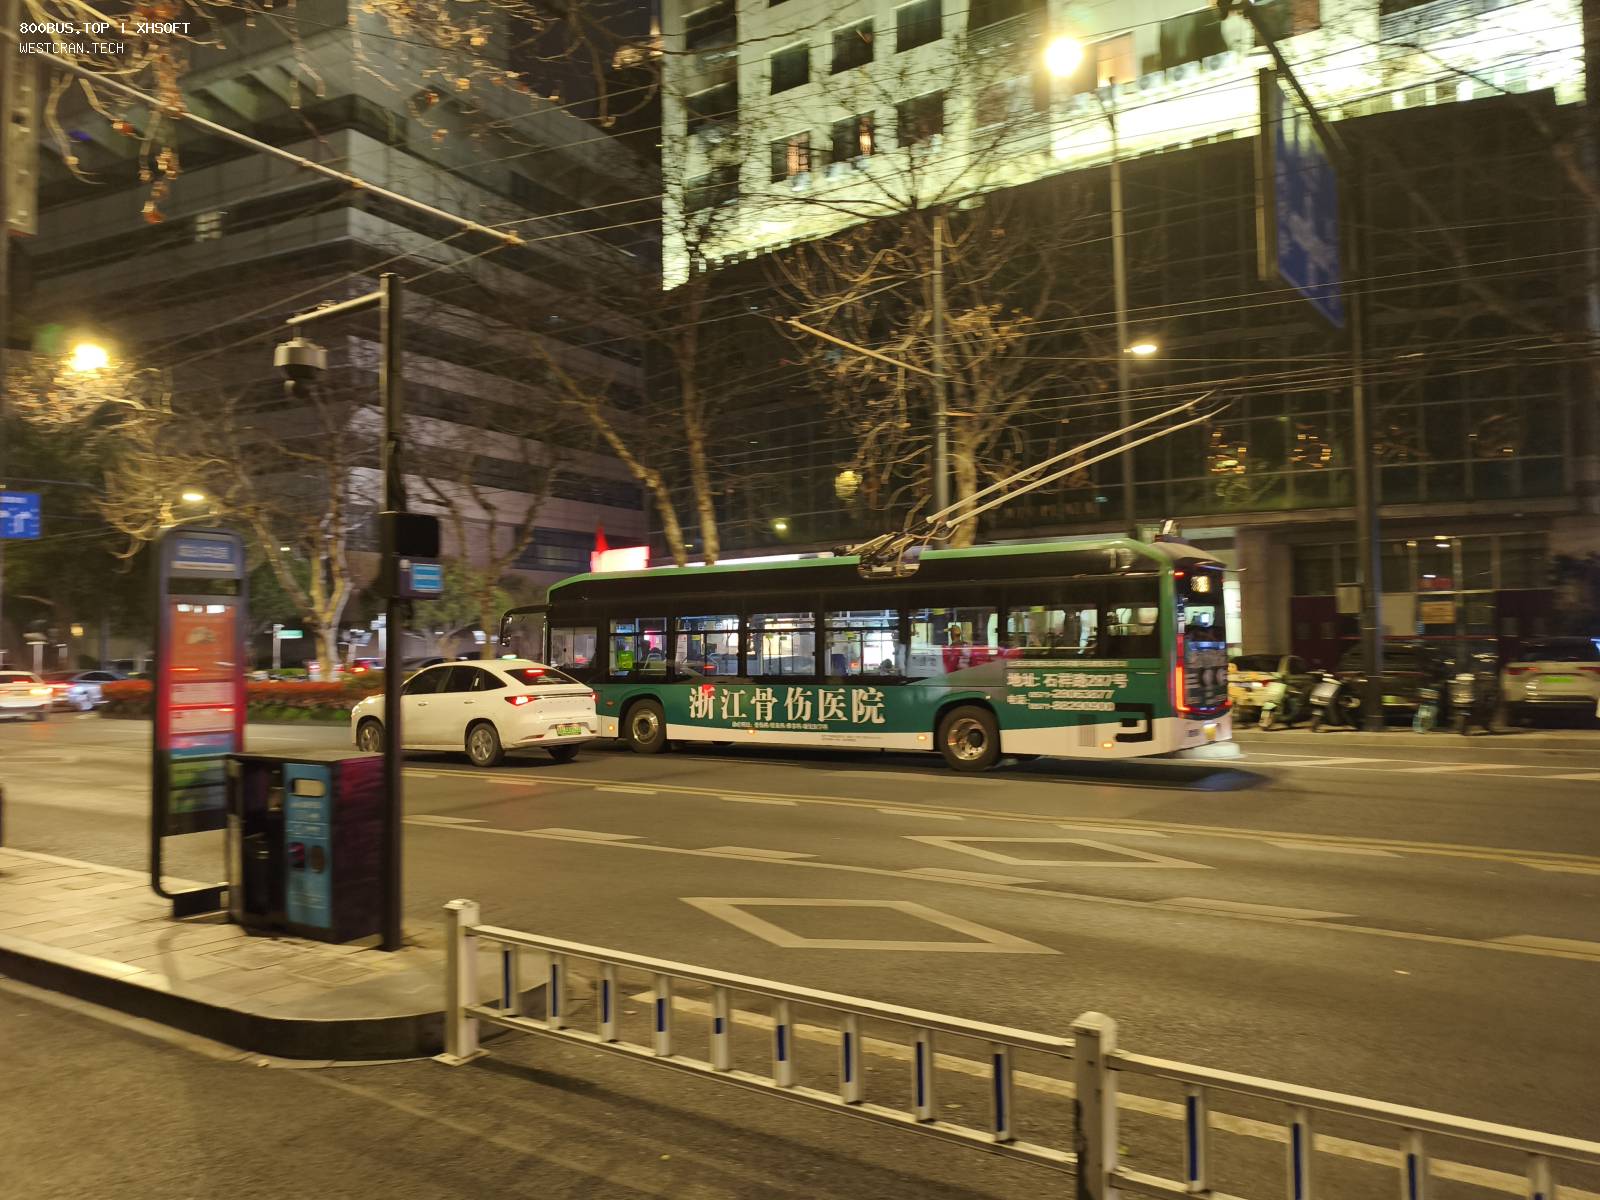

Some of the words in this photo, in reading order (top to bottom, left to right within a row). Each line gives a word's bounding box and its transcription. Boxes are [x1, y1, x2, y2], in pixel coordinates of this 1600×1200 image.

[689, 685, 886, 724] 浙江骨伤医院
